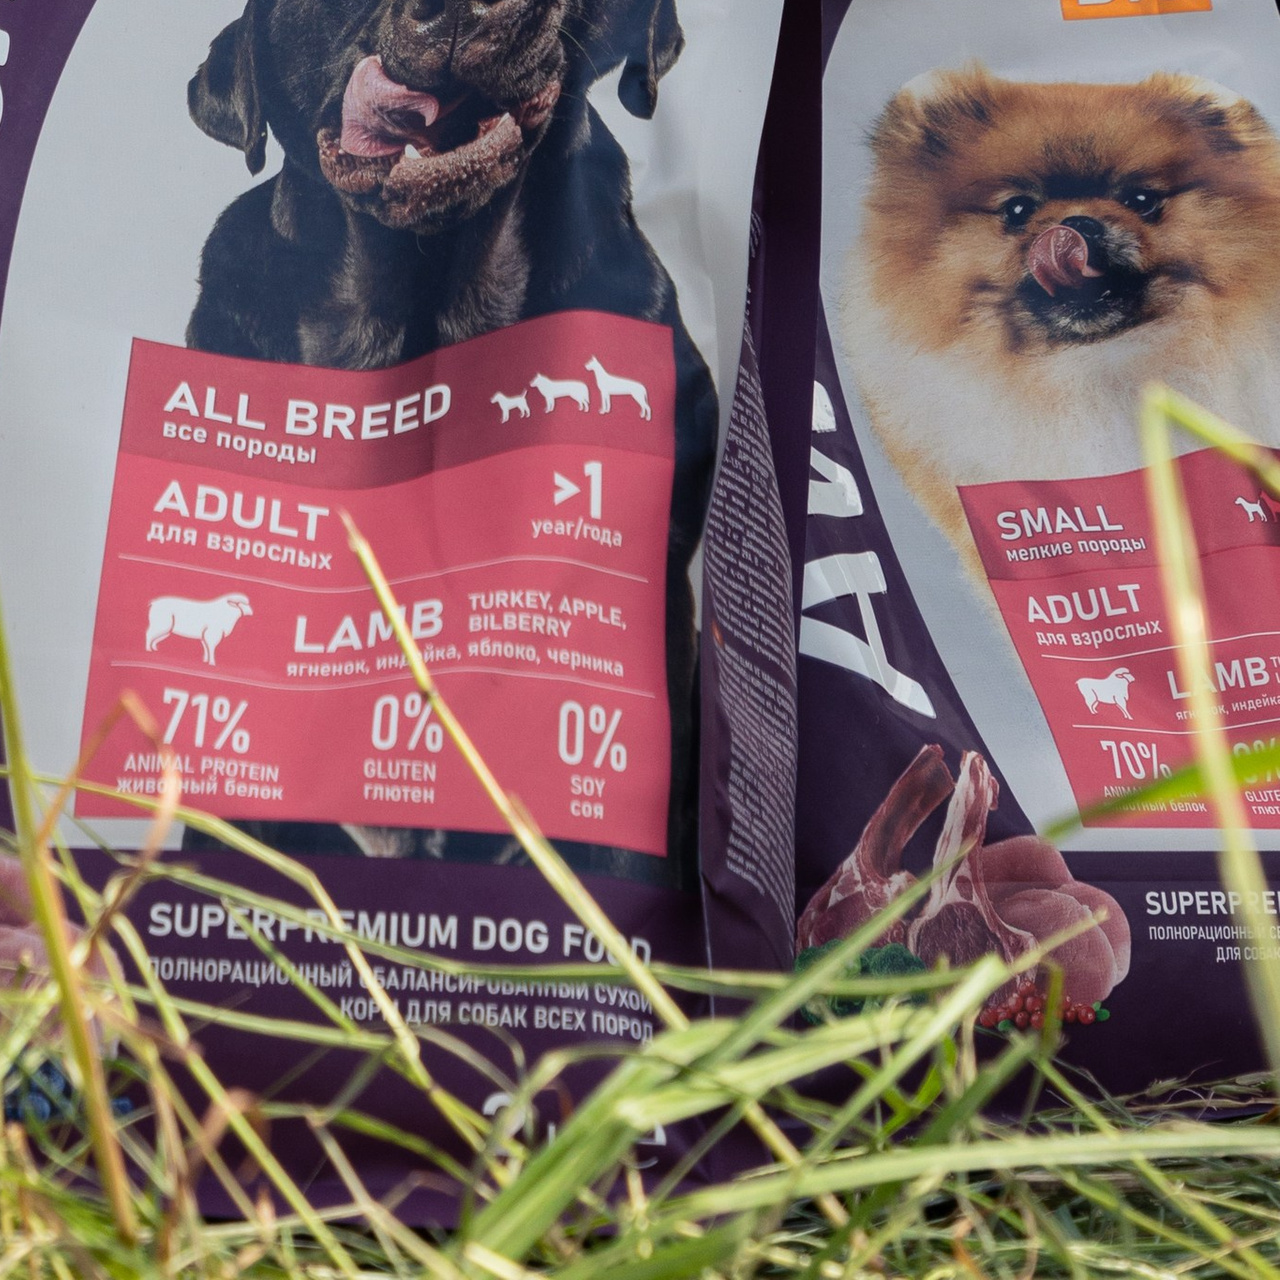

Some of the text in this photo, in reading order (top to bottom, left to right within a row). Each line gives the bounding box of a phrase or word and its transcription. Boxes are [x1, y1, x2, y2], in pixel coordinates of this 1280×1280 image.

[163, 381, 452, 441] ALL BREED
[162, 421, 317, 464] все породы
[153, 479, 329, 541] ADULT
[996, 505, 1123, 540] SMALL
[147, 522, 332, 570] для взрослых
[531, 516, 622, 548] year/года
[1006, 538, 1146, 562] мелкие породы
[468, 590, 627, 630] TURKEY, APPLE,
[1028, 584, 1140, 624] ADULT
[294, 599, 444, 654] LAMB
[468, 611, 571, 638] BILBERRY
[1036, 621, 1162, 648] для взрослых
[287, 637, 624, 677] ягненок, индйка, яблоко, черника
[163, 687, 250, 754] 71%
[372, 692, 443, 753] 0%
[558, 700, 627, 772] 0%
[124, 752, 279, 782] ANIMAL PROTEIN
[364, 759, 437, 782] GLUTEN
[1100, 740, 1173, 779] 70%
[116, 776, 283, 800] живоный белок
[364, 784, 434, 803] глютен
[571, 774, 605, 798] SOY
[571, 800, 604, 819] соя
[1170, 800, 1207, 812] белок
[148, 902, 651, 967] SUPERPREMIUM DOG FOD
[1149, 926, 1265, 942] ПОЛНОРАЦИОНН
[1216, 946, 1241, 963] ДЛЯ
[406, 999, 451, 1025] ДЛЯ
[458, 1001, 527, 1028] СОБАК
[534, 1005, 586, 1031] ВСЕХ
[592, 1010, 653, 1045] ПОРОД
